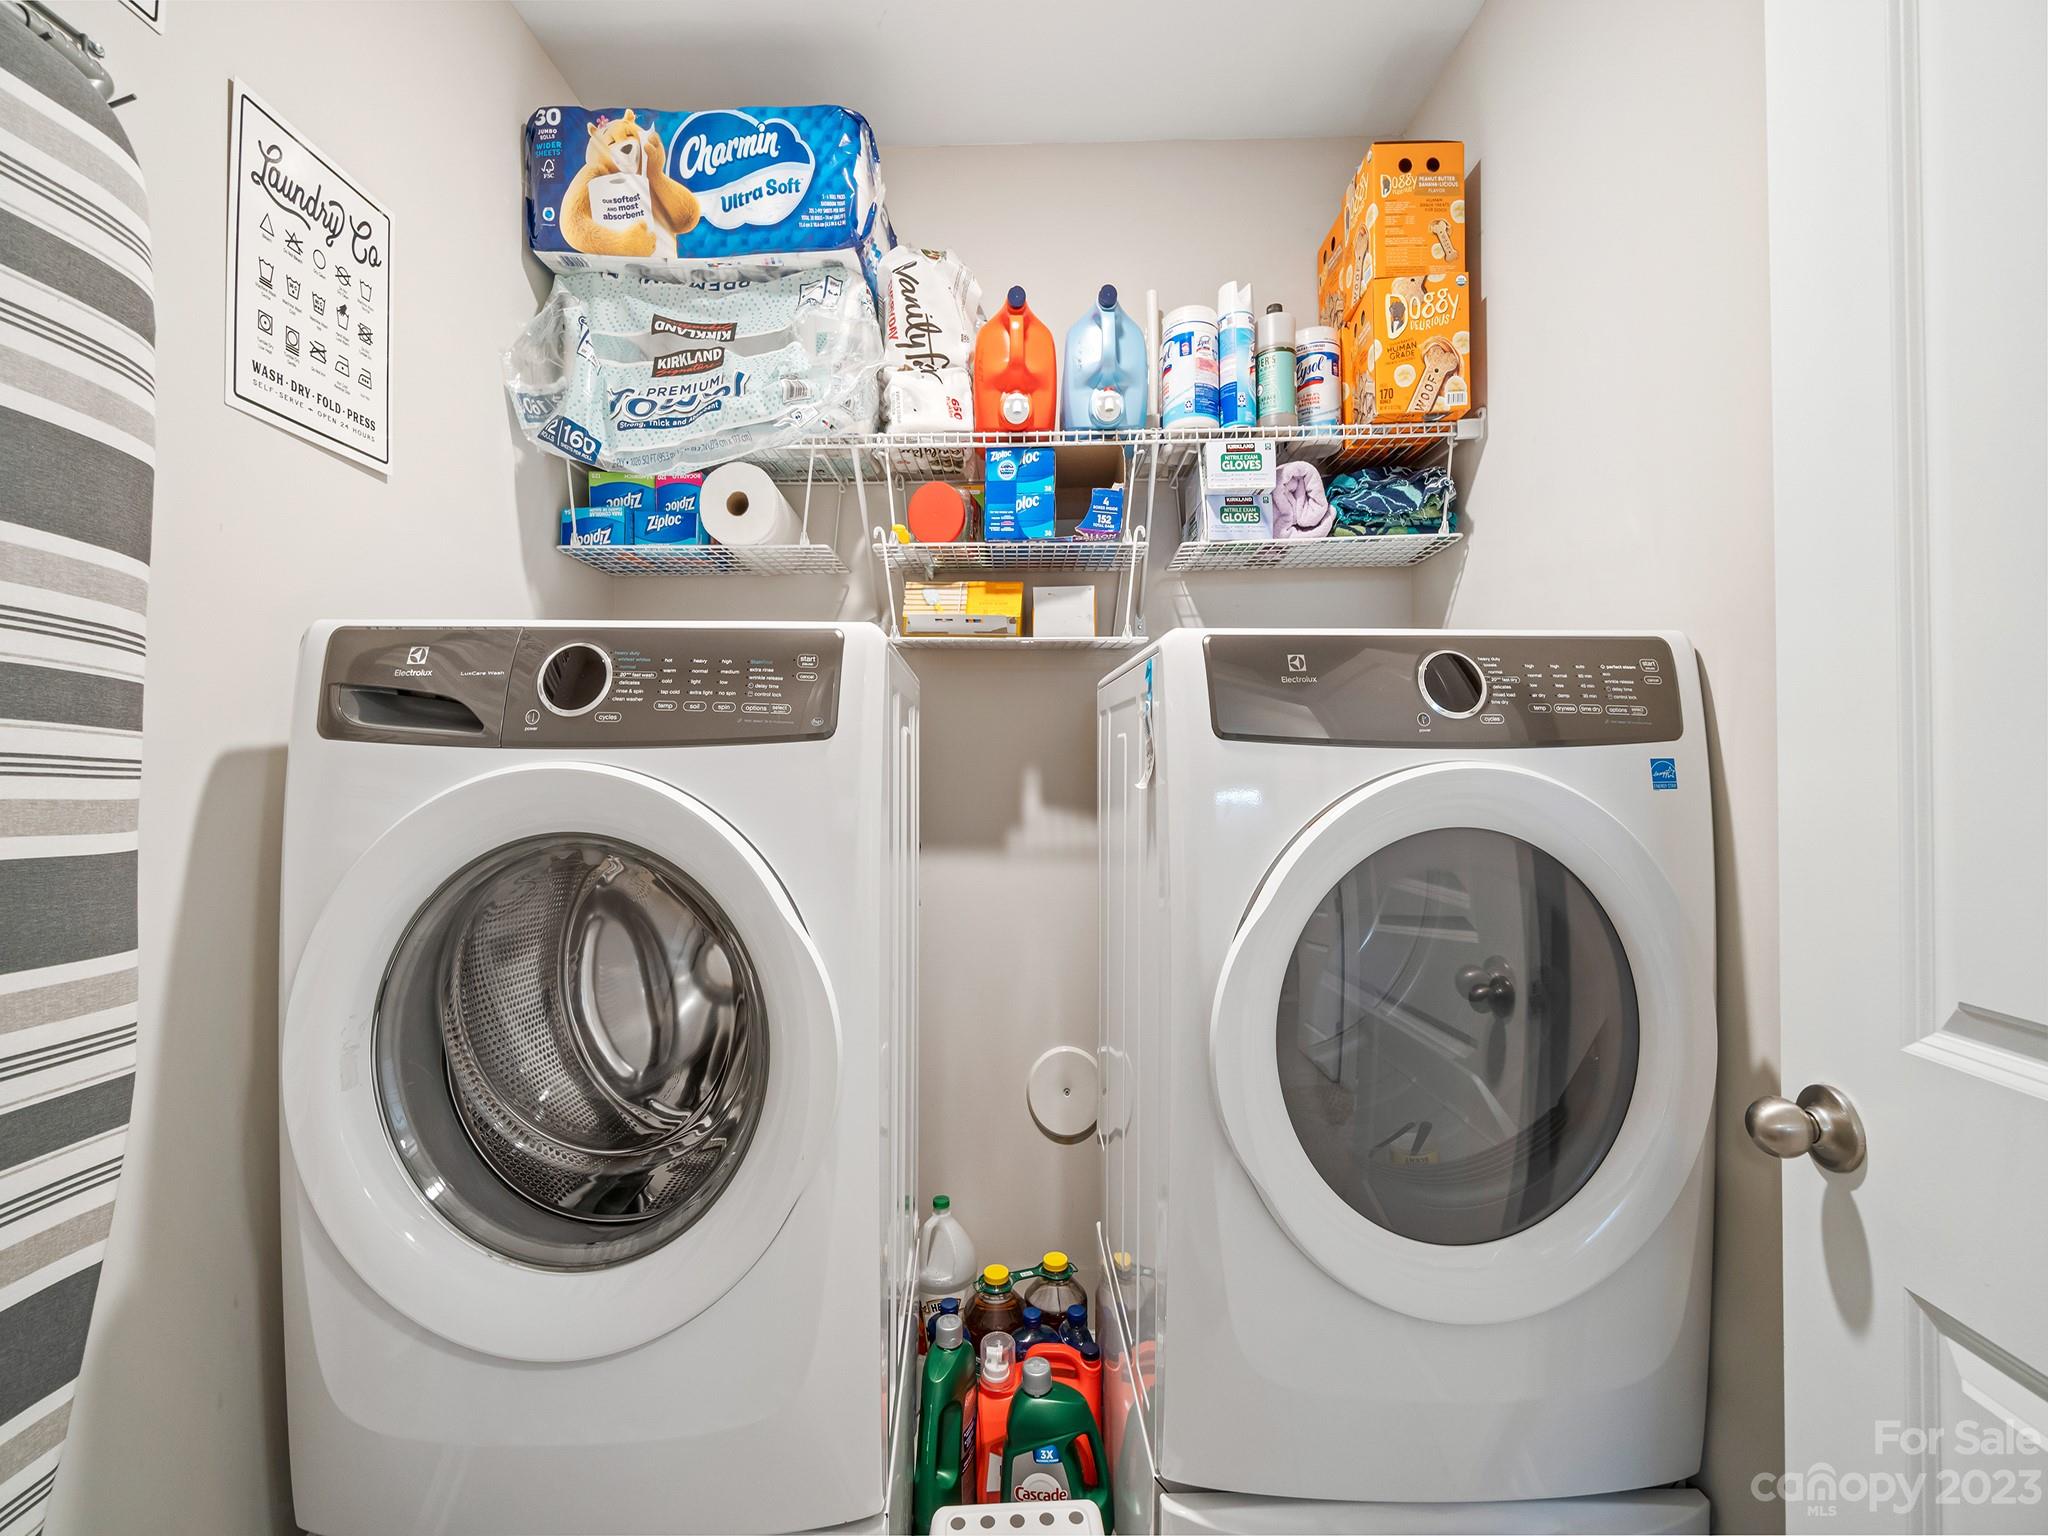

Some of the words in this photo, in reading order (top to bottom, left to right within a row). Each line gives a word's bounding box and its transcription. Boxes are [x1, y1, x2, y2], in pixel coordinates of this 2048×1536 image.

[534, 108, 561, 126] 30
[538, 128, 558, 136] JUMBO
[535, 140, 562, 149] WIDER
[679, 123, 780, 179] Charmin
[535, 148, 561, 157] SHEETS
[1380, 173, 1418, 198] Doggy
[612, 193, 641, 204] softest
[720, 185, 764, 213] Ultra
[765, 177, 801, 196] Soft
[250, 138, 344, 247] Laundry
[350, 215, 383, 268] Co
[618, 202, 639, 211] most
[603, 209, 645, 220] absorbent
[891, 260, 943, 350] Vanity
[1384, 287, 1460, 340] Doggy
[654, 320, 732, 341] KIRKLAND
[1386, 341, 1418, 354] HUMAN
[1388, 349, 1416, 361] GRADE
[657, 348, 723, 369] KIRKLAND
[1295, 355, 1325, 385] Lysol
[646, 375, 721, 397] PREMIUM
[1379, 387, 1394, 400] 170
[1414, 374, 1438, 412] WOOF
[251, 359, 284, 387] WASH
[290, 379, 311, 400] DRY
[316, 393, 342, 415] FOLD
[346, 408, 377, 432] PRESS
[951, 397, 963, 421] 650
[317, 410, 338, 425] OPEN
[339, 421, 350, 430] 24
[352, 426, 376, 443] HOURS
[672, 418, 687, 426] and
[563, 424, 597, 454] 160
[560, 442, 574, 453] SHEETS
[581, 452, 593, 462] ROLL
[990, 450, 1012, 462] Ziploc
[1222, 460, 1262, 471] GLOVES
[606, 492, 643, 509] Ziploc
[665, 496, 696, 513] Ziploc
[1102, 496, 1110, 507] 4
[646, 513, 682, 532] Ziploc
[1096, 513, 1113, 525] 152
[1221, 513, 1260, 523] GLOVES
[799, 655, 817, 663] start
[394, 668, 433, 678] Electrolux
[1280, 675, 1318, 684] Electrolux
[745, 704, 767, 712] options
[598, 713, 618, 721] cycles
[1040, 1449, 1054, 1460] 3X
[1014, 1485, 1067, 1502] Cascade
